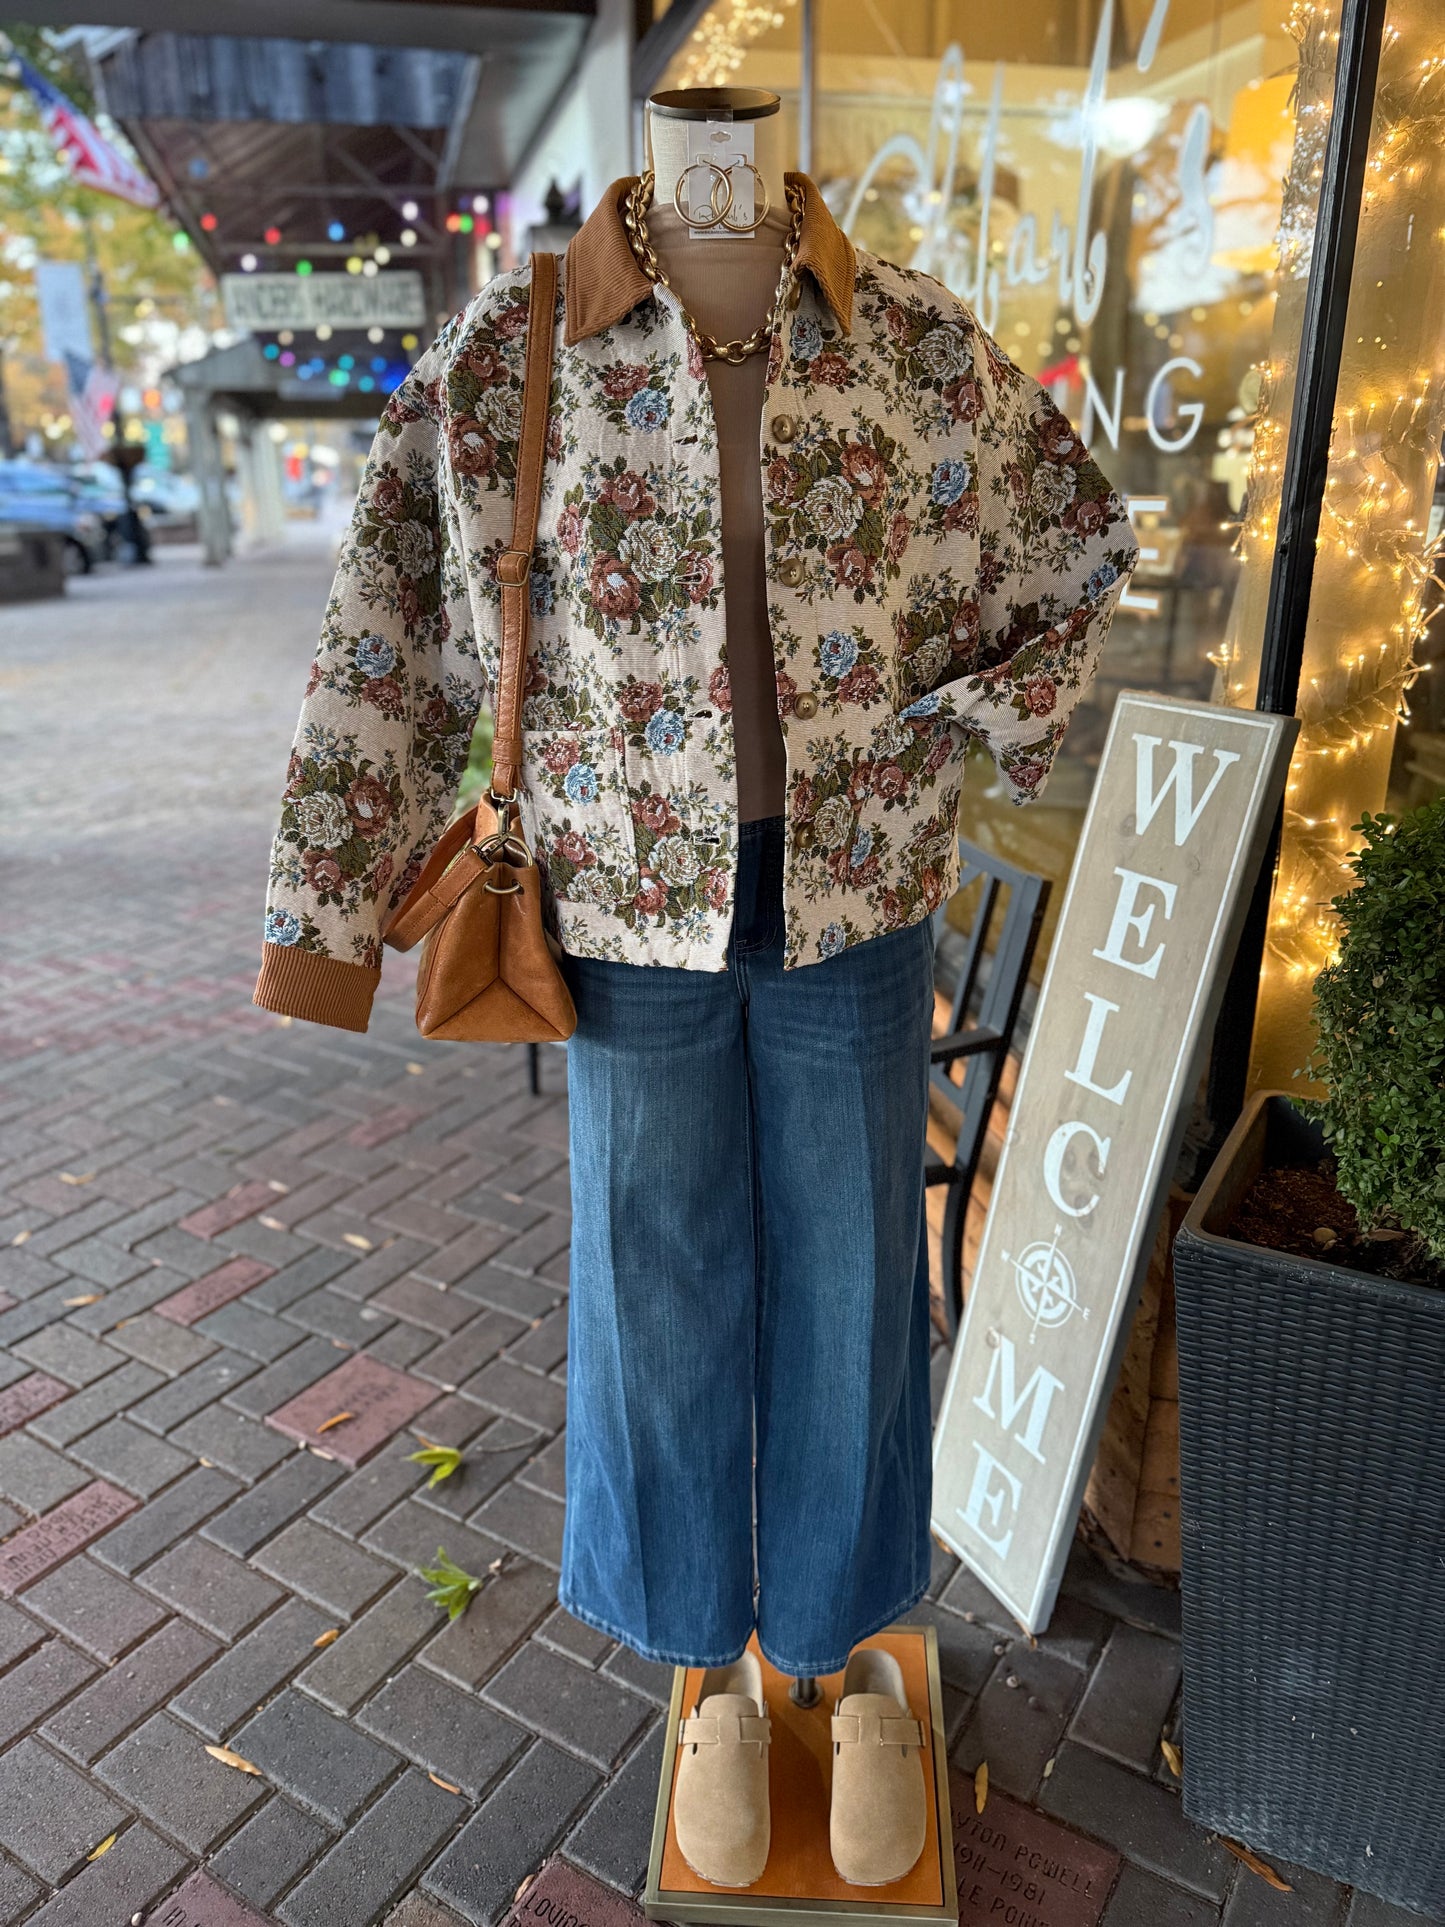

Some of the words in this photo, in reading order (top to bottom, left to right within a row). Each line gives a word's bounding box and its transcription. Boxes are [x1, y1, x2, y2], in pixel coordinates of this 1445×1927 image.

[1080, 356, 1204, 453] NG
[951, 1809, 1007, 1852] YTON
[1014, 1844, 1094, 1900] POWELL
[957, 1877, 983, 1906] LE
